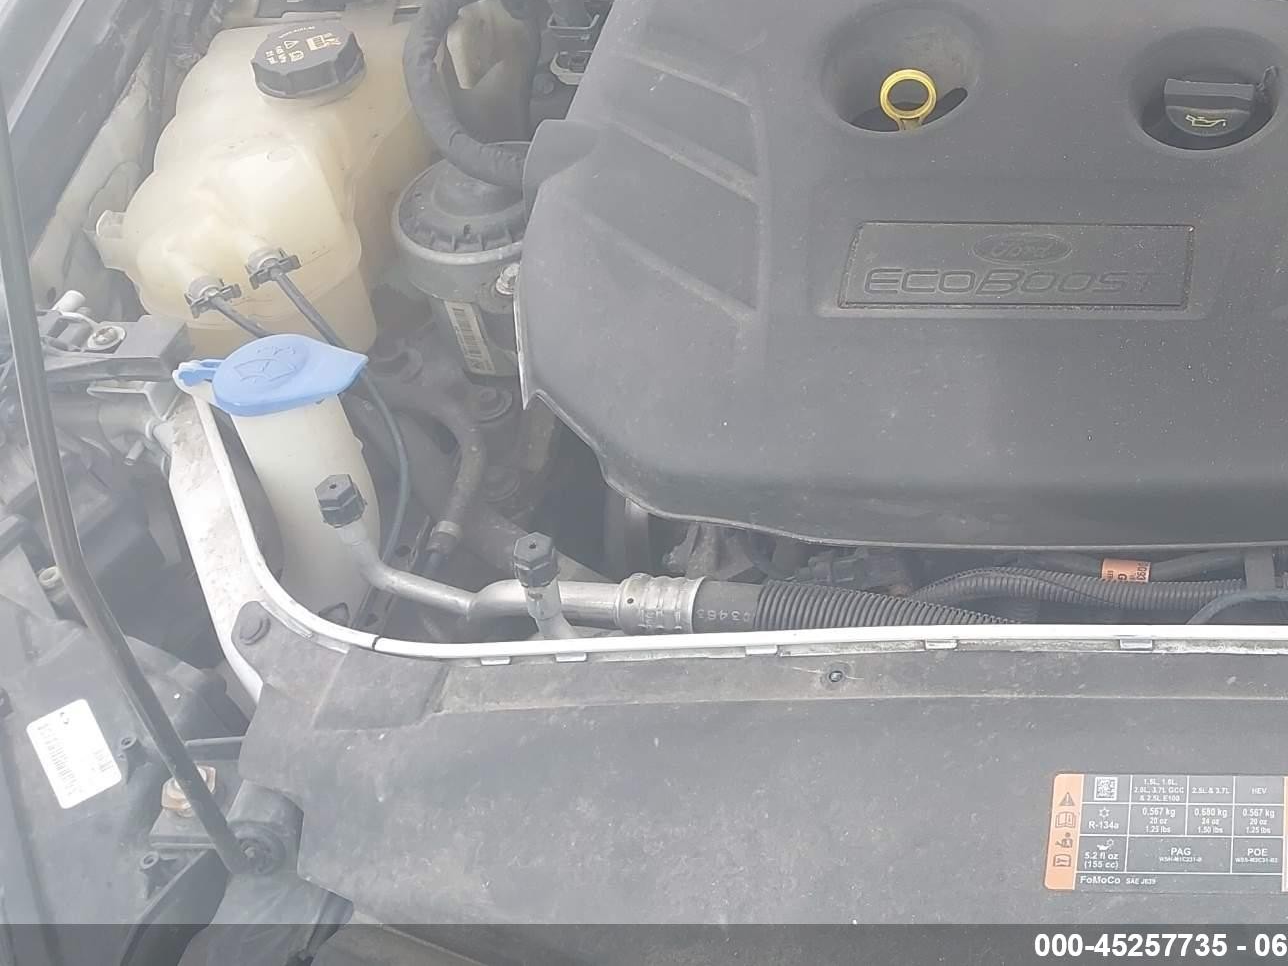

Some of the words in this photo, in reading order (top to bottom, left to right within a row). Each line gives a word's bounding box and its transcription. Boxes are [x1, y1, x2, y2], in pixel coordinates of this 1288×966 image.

[1168, 786, 1185, 794] GCC
[1251, 787, 1267, 795] HEV
[1162, 794, 1181, 802] E100
[1142, 807, 1164, 816] 0.567
[1165, 807, 1176, 818] kg
[1194, 807, 1216, 816] 0.680
[1217, 808, 1228, 819] kg
[1242, 808, 1263, 817] 0.567
[1265, 808, 1275, 819] kg
[1088, 820, 1120, 830] R-134a
[1149, 817, 1158, 825] 20
[1201, 817, 1210, 825] 24
[1145, 825, 1159, 833] 1.25
[1160, 825, 1171, 833] lbs
[1197, 826, 1211, 834] 1.50
[1213, 826, 1223, 834] lbs
[1246, 826, 1259, 834] 1.25
[1260, 826, 1271, 834] lbs
[1084, 851, 1098, 860] 5.2
[1099, 851, 1106, 860] fl
[1170, 847, 1192, 856] PAG
[1247, 848, 1268, 857] POE
[1084, 861, 1103, 870] (155
[1104, 861, 1119, 871] cc)
[1079, 875, 1121, 884] FoMoCo
[1125, 877, 1140, 885] SAE
